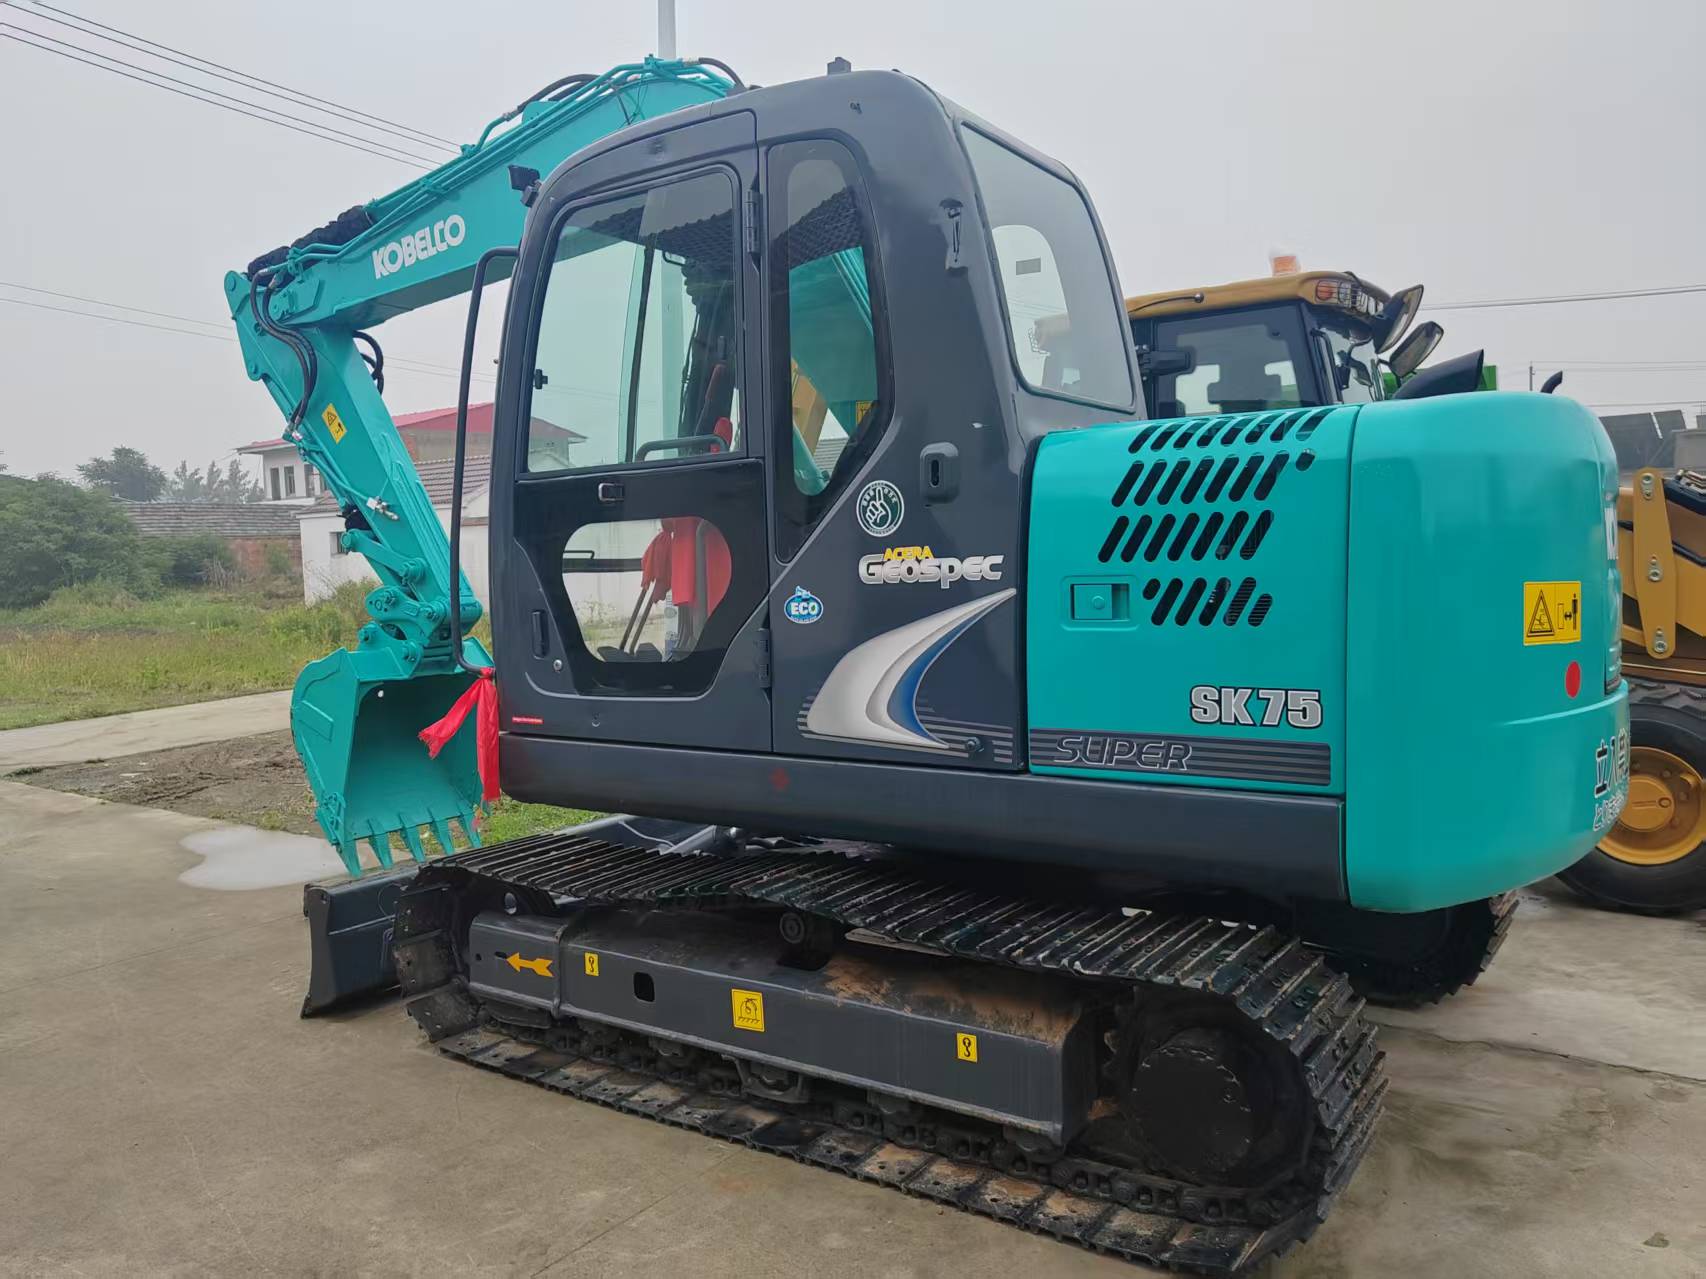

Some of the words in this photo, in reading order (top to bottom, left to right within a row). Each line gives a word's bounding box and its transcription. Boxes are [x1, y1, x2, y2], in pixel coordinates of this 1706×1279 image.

[372, 214, 466, 279] KOBELCO
[884, 545, 935, 560] ACERA
[790, 602, 818, 615] ECO
[1190, 685, 1323, 728] SK75
[1053, 735, 1193, 770] SUPER
